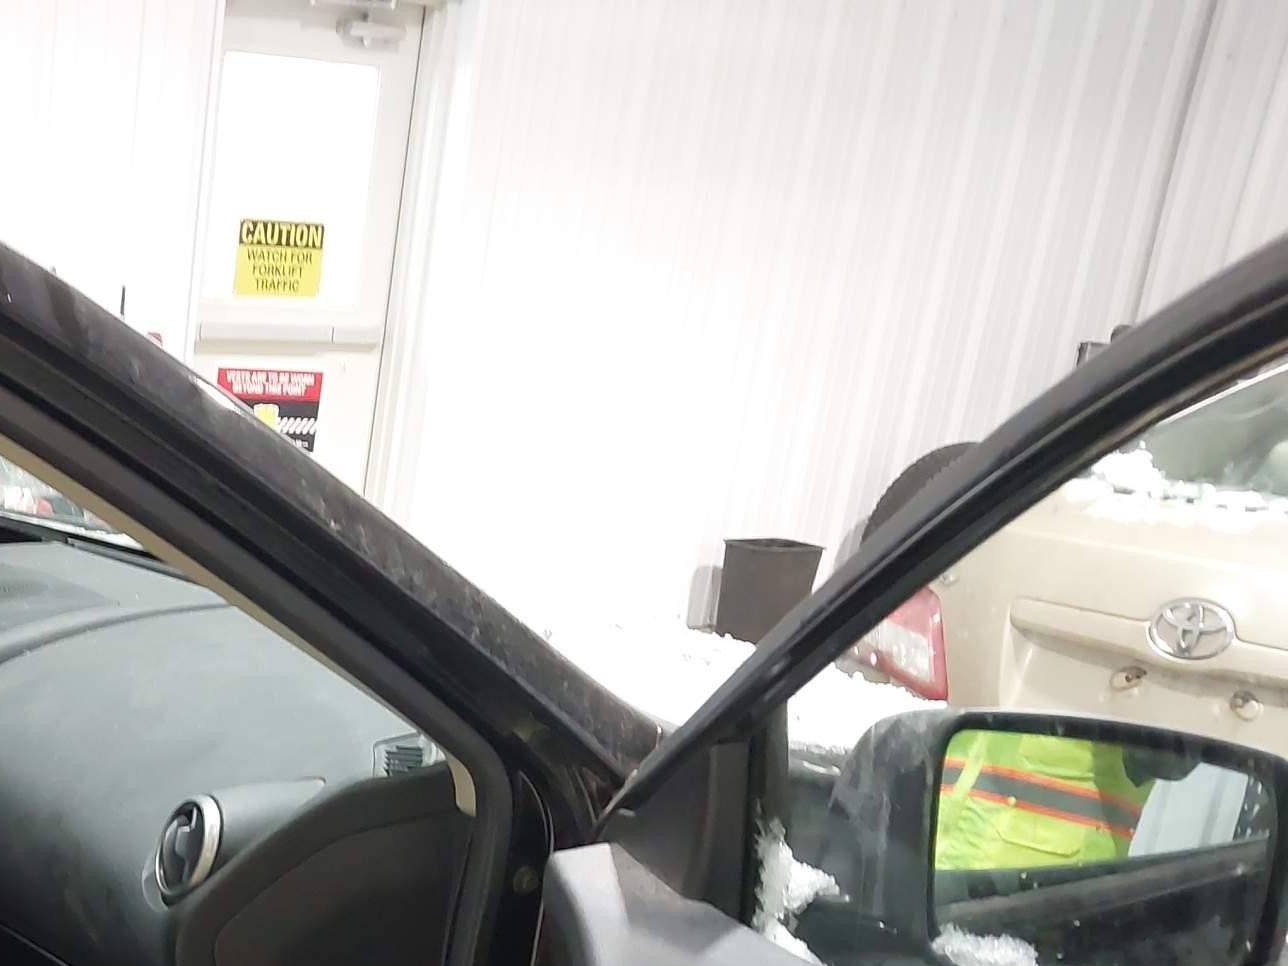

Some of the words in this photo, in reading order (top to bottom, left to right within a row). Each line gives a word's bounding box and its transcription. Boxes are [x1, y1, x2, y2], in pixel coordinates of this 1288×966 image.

[241, 221, 323, 248] CAUTION
[247, 248, 288, 263] WATCH
[290, 251, 313, 264] FOR
[252, 264, 303, 278] FORKLIFT
[255, 278, 300, 292] TRAFFIC
